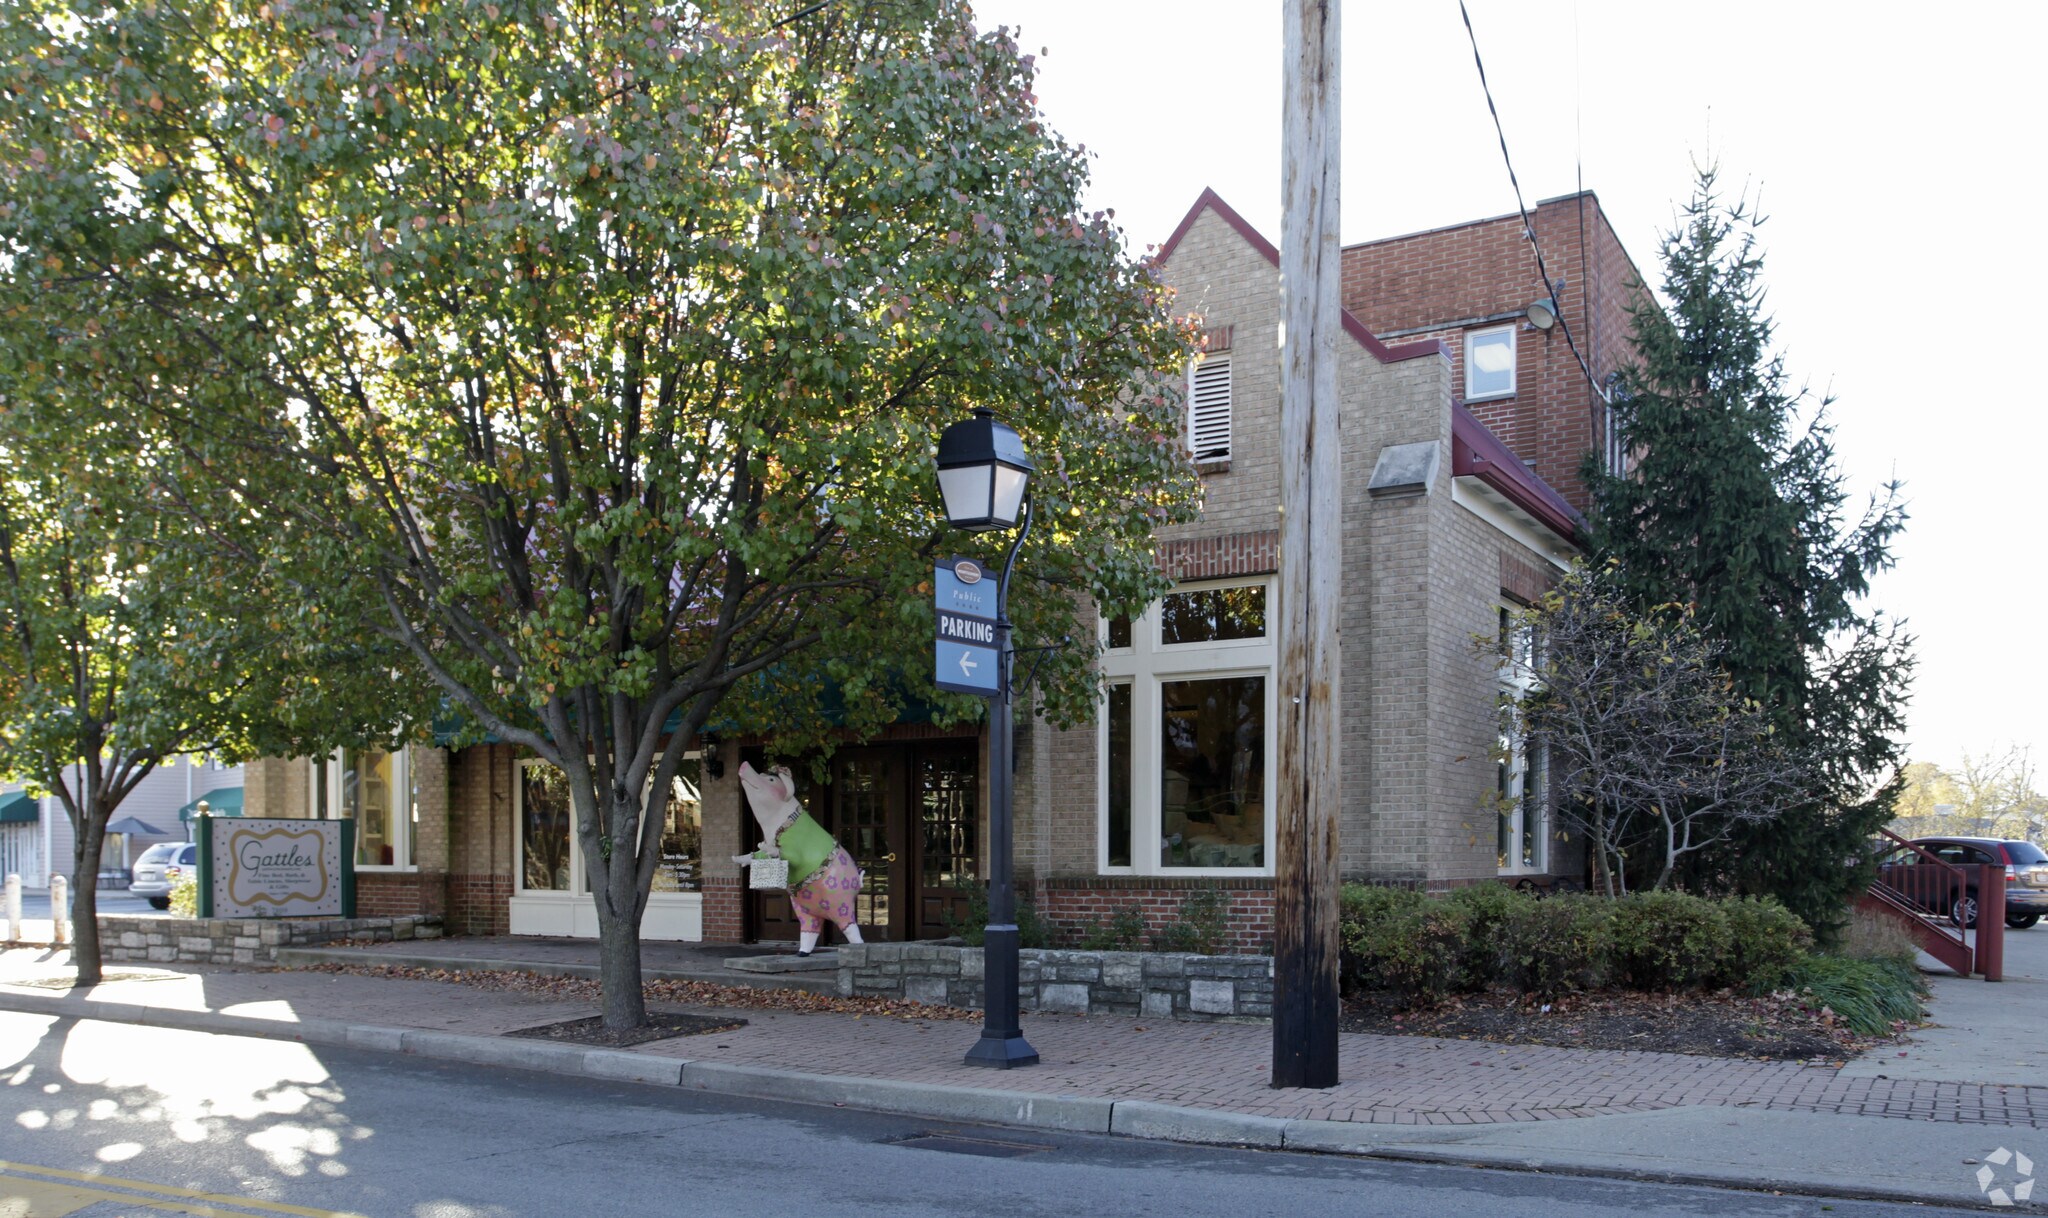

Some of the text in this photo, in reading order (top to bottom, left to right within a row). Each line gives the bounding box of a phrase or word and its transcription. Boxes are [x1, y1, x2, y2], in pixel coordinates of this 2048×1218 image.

[953, 589, 982, 603] Public
[941, 615, 993, 643] PARKING
[240, 840, 315, 877] Gattles
